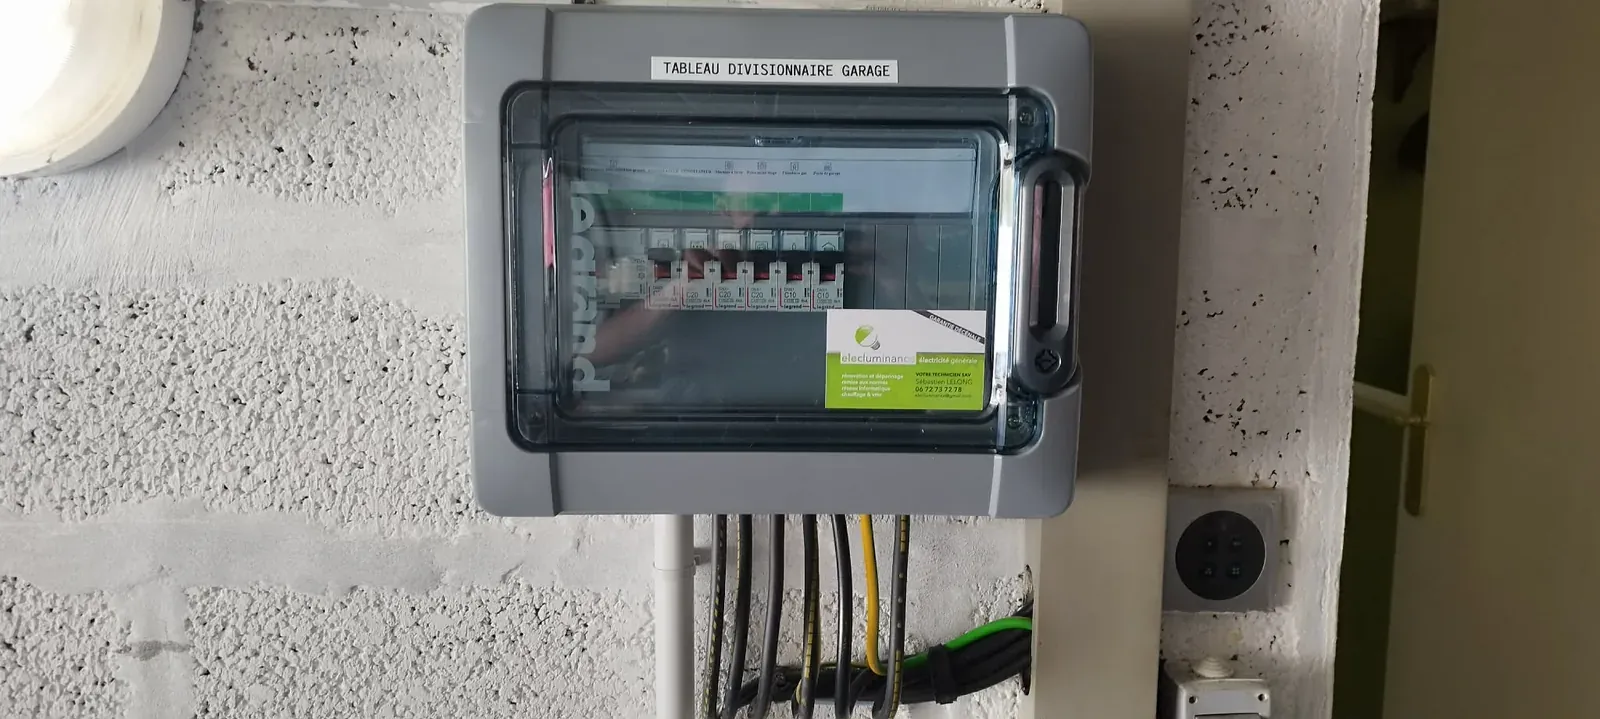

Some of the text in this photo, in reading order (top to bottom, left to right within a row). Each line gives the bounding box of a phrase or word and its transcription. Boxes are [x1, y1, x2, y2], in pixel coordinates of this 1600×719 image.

[663, 61, 891, 78] TABLEAU DIVISIONNAIRE GARAGE
[570, 181, 610, 391] legrand
[784, 291, 796, 299] C10
[841, 353, 915, 363] elecluminanc
[919, 356, 978, 365] électricité générale
[915, 378, 946, 386] Sébastien
